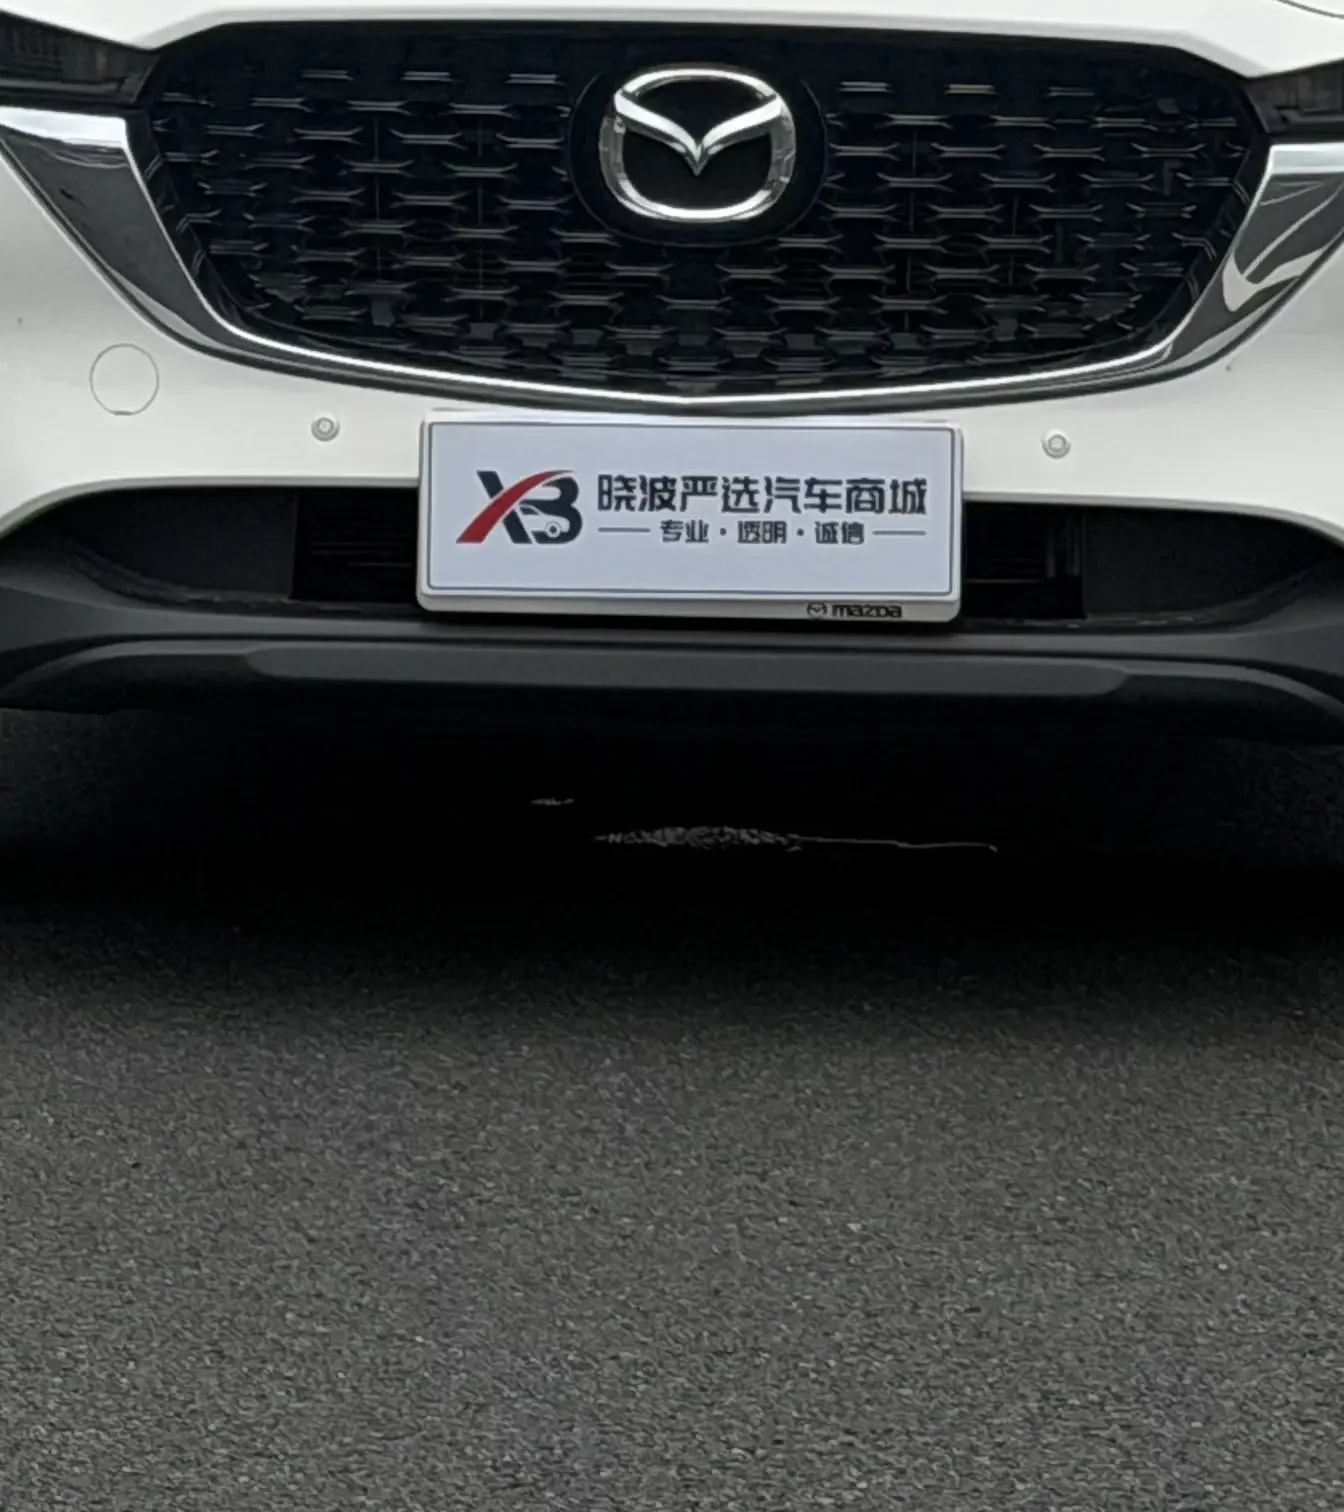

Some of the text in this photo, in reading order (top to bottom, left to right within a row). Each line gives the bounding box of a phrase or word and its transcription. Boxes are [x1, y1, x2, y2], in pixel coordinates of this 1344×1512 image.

[597, 474, 928, 515] 晓波严选汽车商城
[832, 604, 903, 619] mazda
